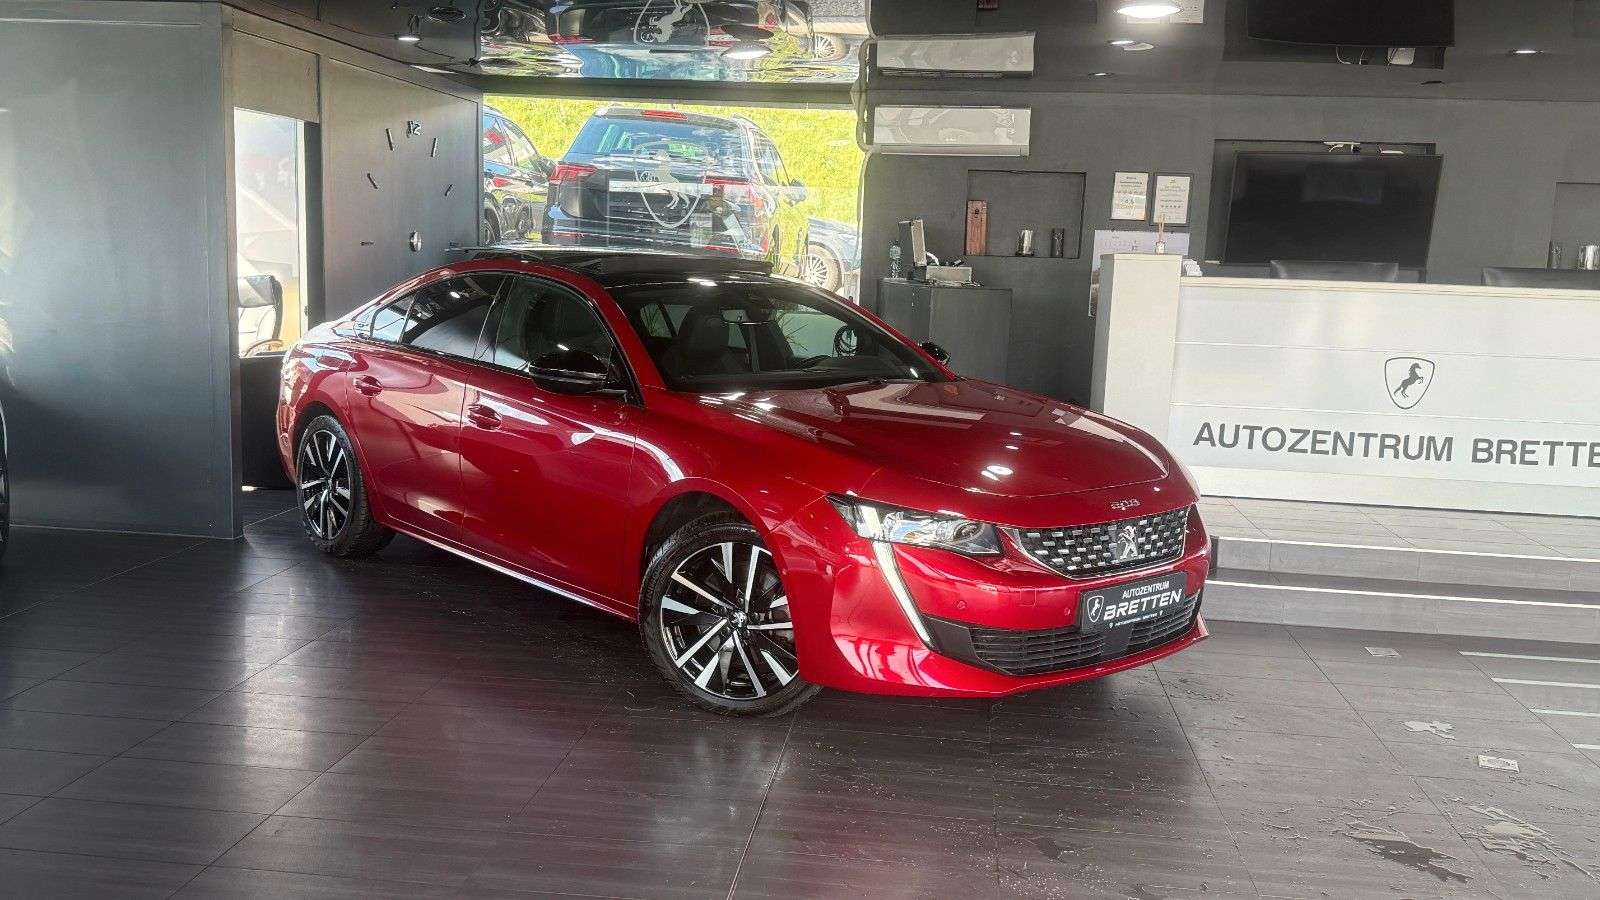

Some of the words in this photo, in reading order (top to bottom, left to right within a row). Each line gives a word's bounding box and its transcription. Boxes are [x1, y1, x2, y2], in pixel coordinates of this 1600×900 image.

[407, 120, 422, 136] 12
[1193, 422, 1454, 462] AUTOZENTRUM
[1471, 438, 1600, 468] BRETTE
[1122, 581, 1170, 599] AUTOZENTRUM
[1103, 588, 1183, 621] BRETTEN
